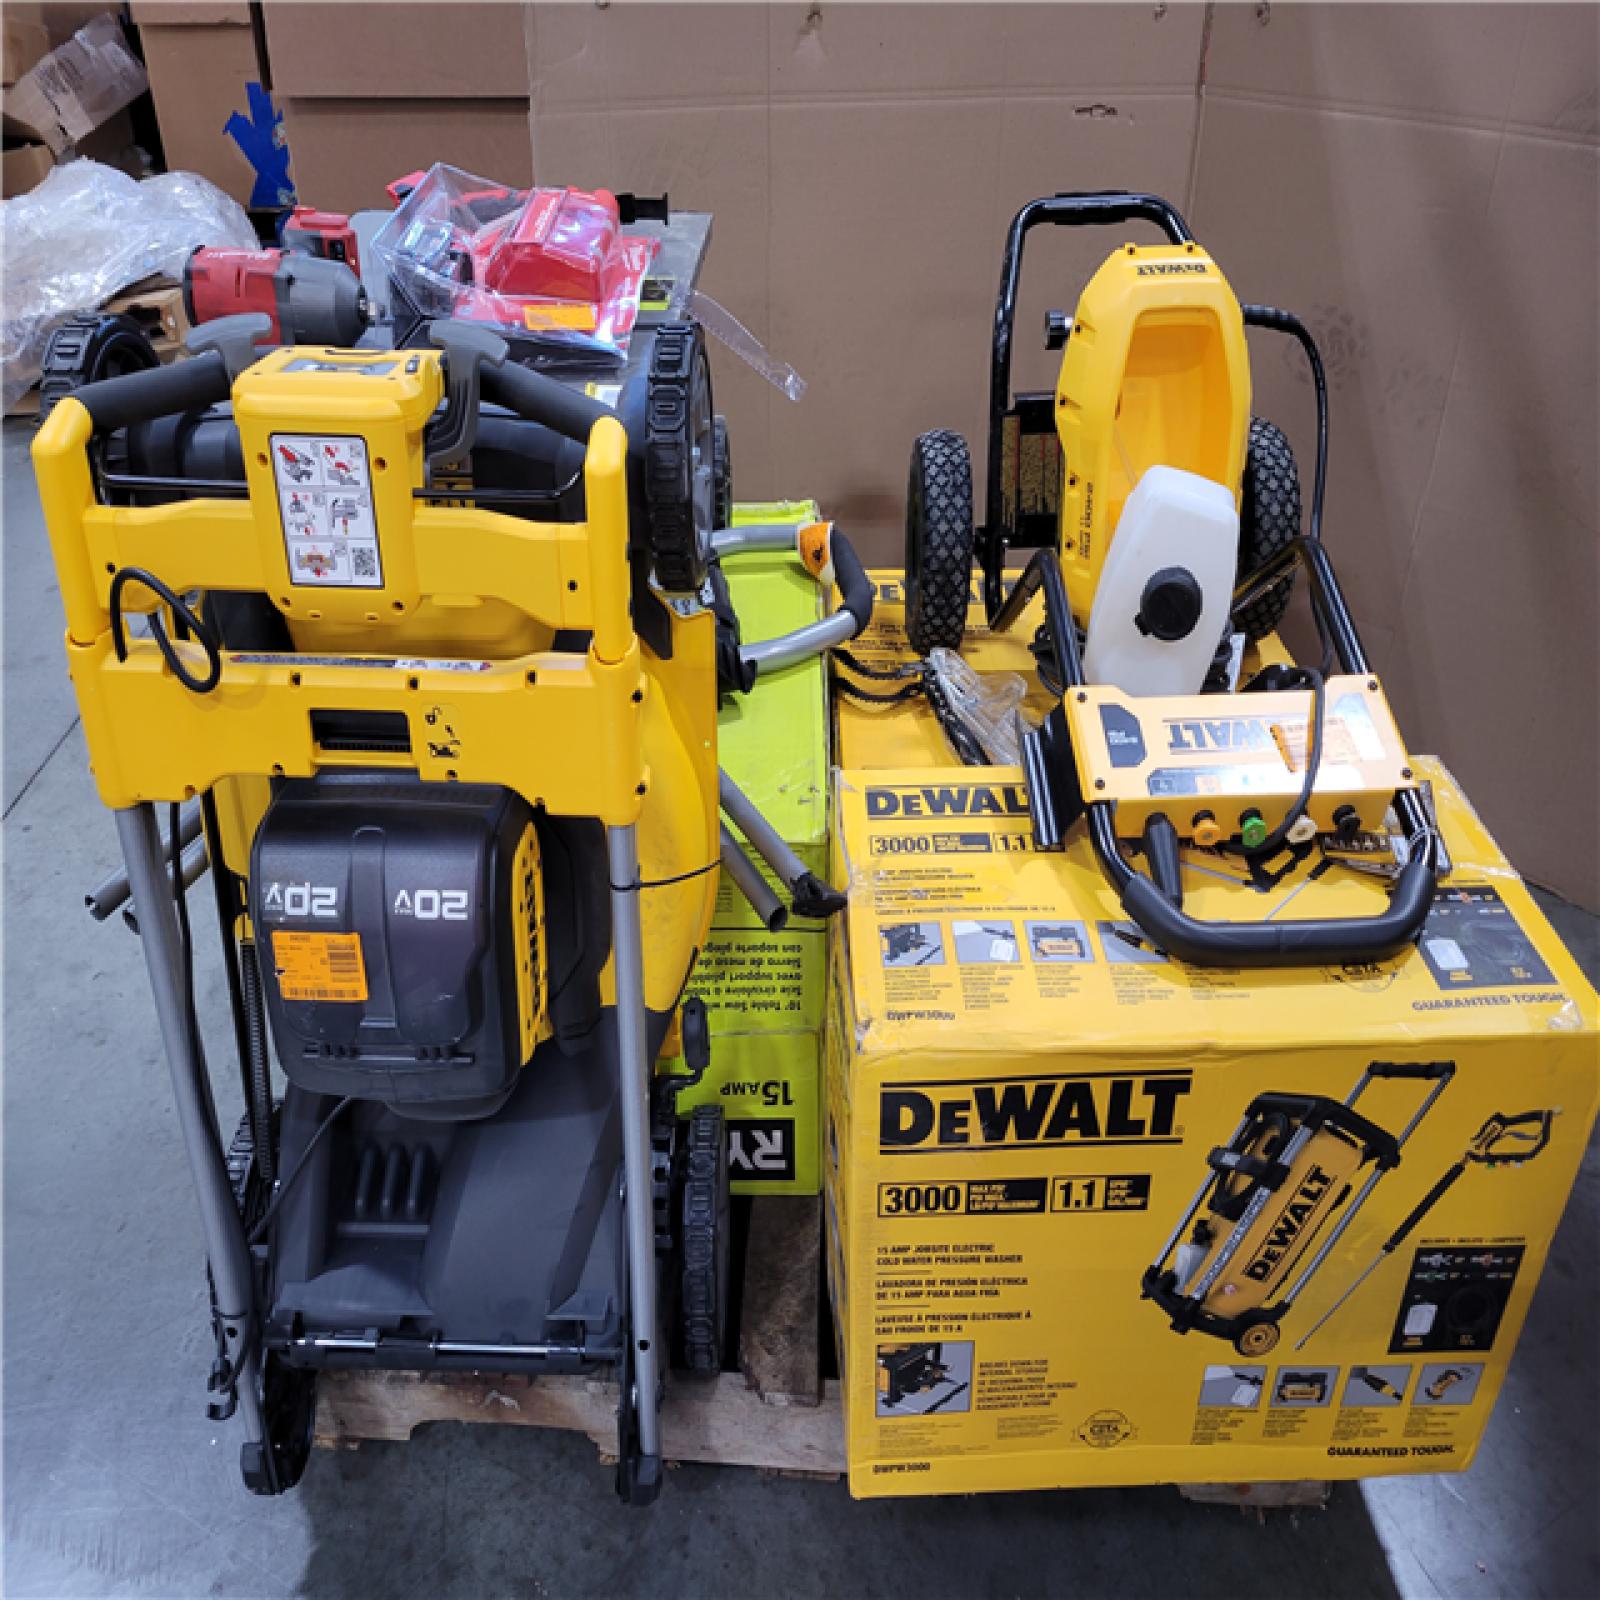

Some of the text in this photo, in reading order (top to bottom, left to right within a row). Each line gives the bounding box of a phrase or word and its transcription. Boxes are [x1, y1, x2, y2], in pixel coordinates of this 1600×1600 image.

[866, 787, 1030, 816] DEWAL
[875, 836, 931, 854] 3000
[999, 835, 1026, 851] 1.1
[720, 1081, 794, 1106] 15 AMP
[879, 1079, 1192, 1146] DEWALT
[885, 1184, 961, 1214] 3000
[1059, 1179, 1094, 1209] 1.1
[1246, 1165, 1335, 1283] DEWALT
[1327, 1446, 1408, 1458] GUARANTEED
